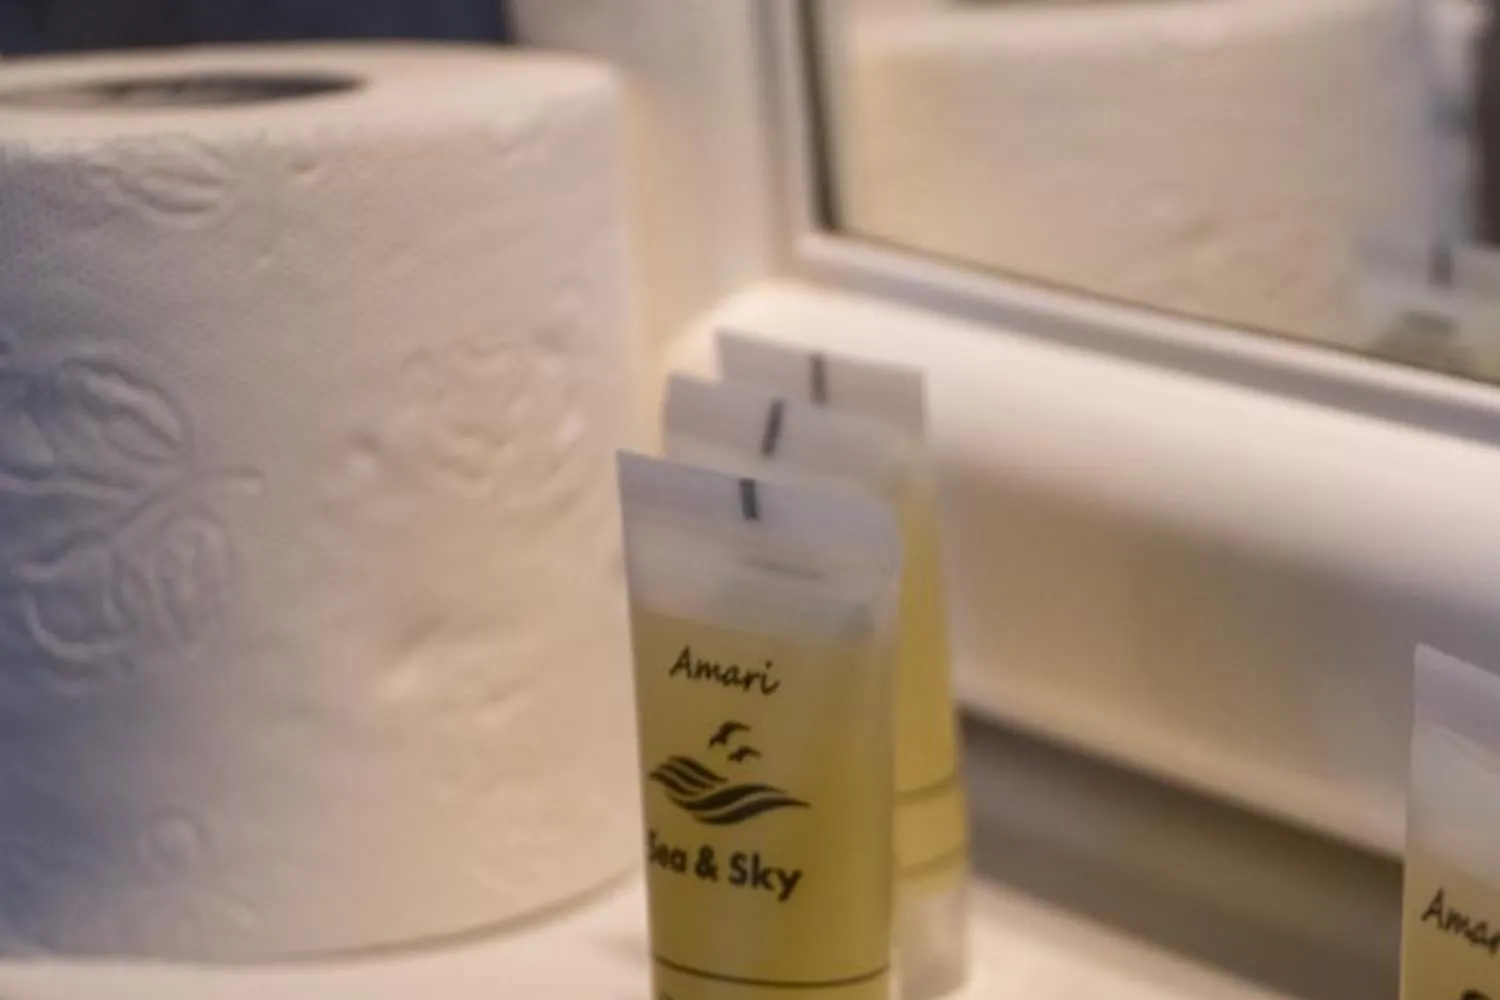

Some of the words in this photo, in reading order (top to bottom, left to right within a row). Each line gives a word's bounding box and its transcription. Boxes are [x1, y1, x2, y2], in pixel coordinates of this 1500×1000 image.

[669, 645, 781, 696] Amari
[695, 845, 719, 883] &
[729, 852, 803, 903] Sky
